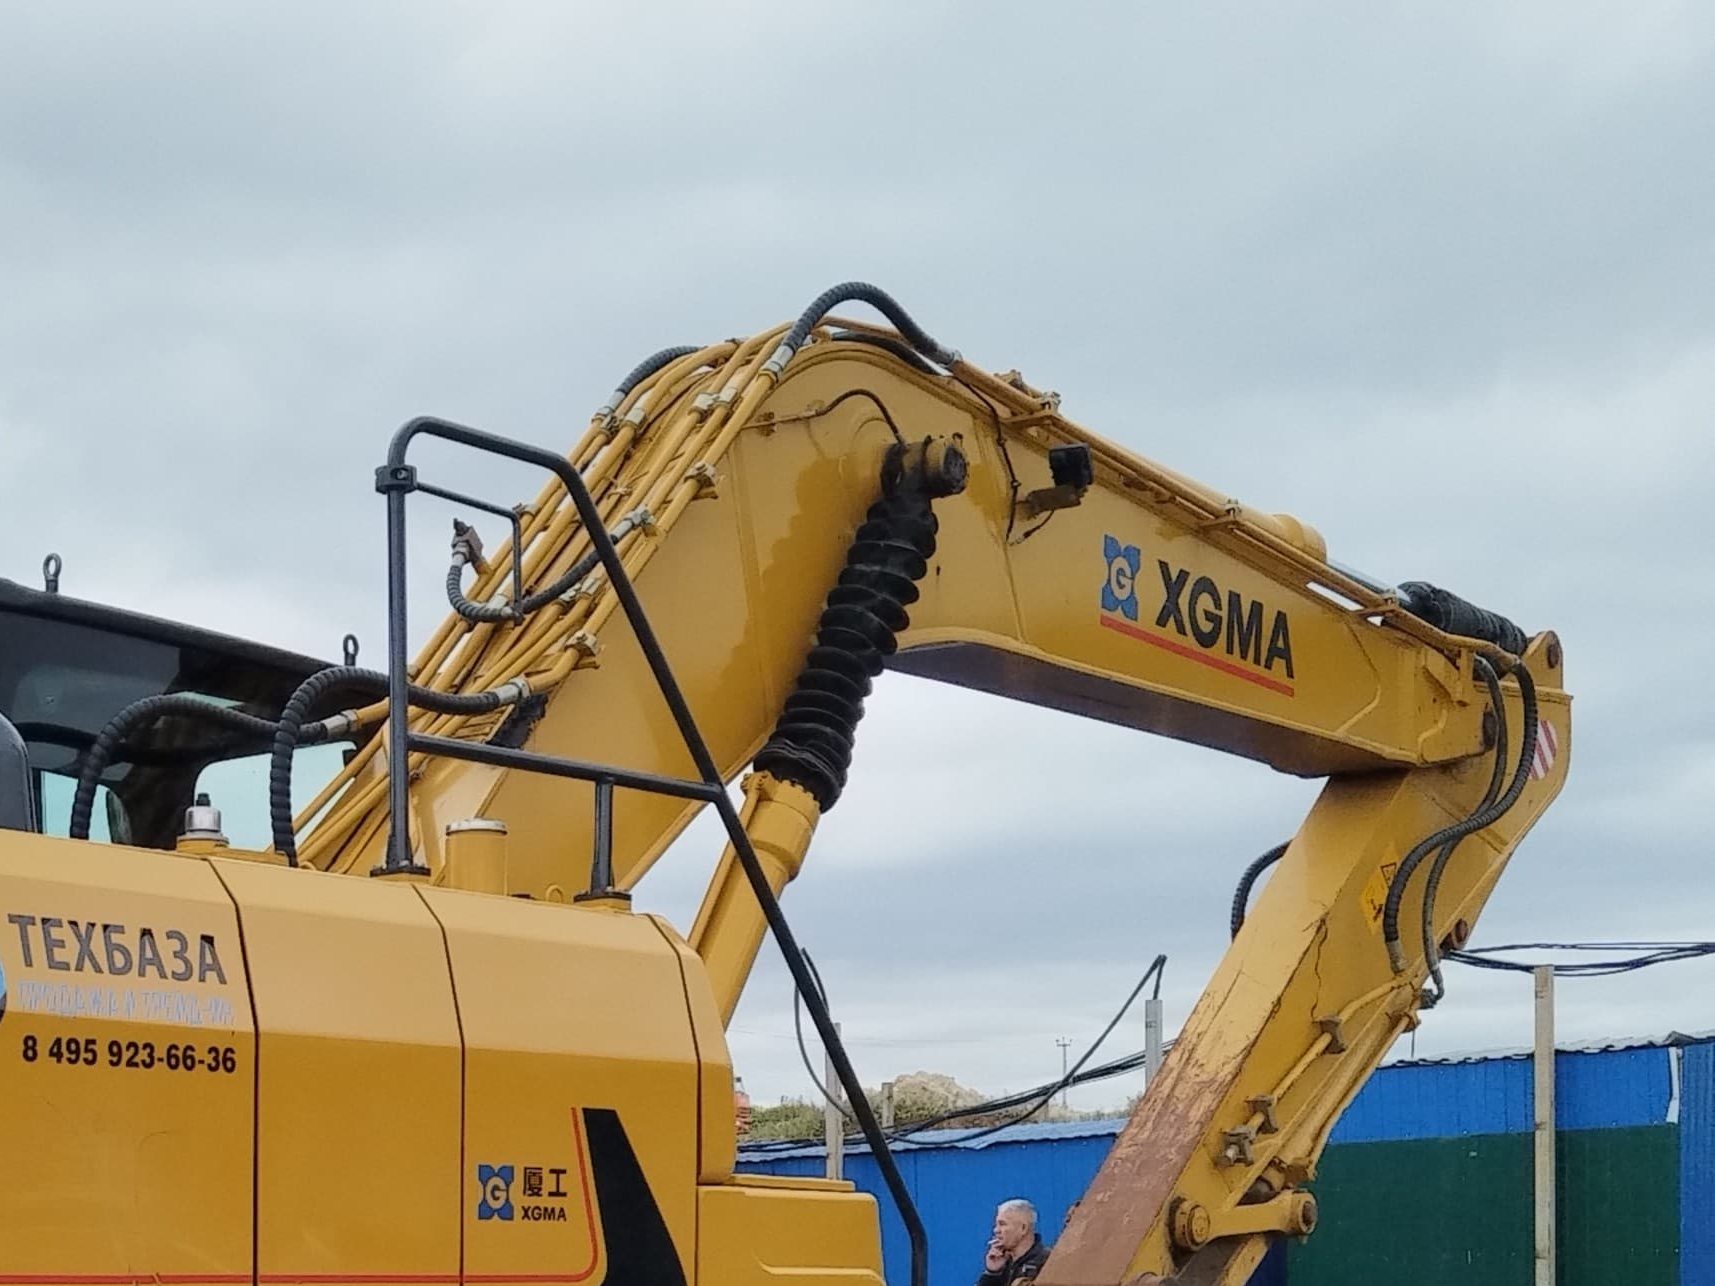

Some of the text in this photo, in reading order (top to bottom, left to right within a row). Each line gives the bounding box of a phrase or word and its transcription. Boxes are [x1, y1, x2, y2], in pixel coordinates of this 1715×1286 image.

[1155, 559, 1294, 679] XGMA
[7, 913, 228, 985] ТЕХБАЗА
[22, 1035, 236, 1074] 8 495 923-66-36
[522, 1166, 568, 1197] 厦工
[521, 1205, 567, 1222] XGMA
